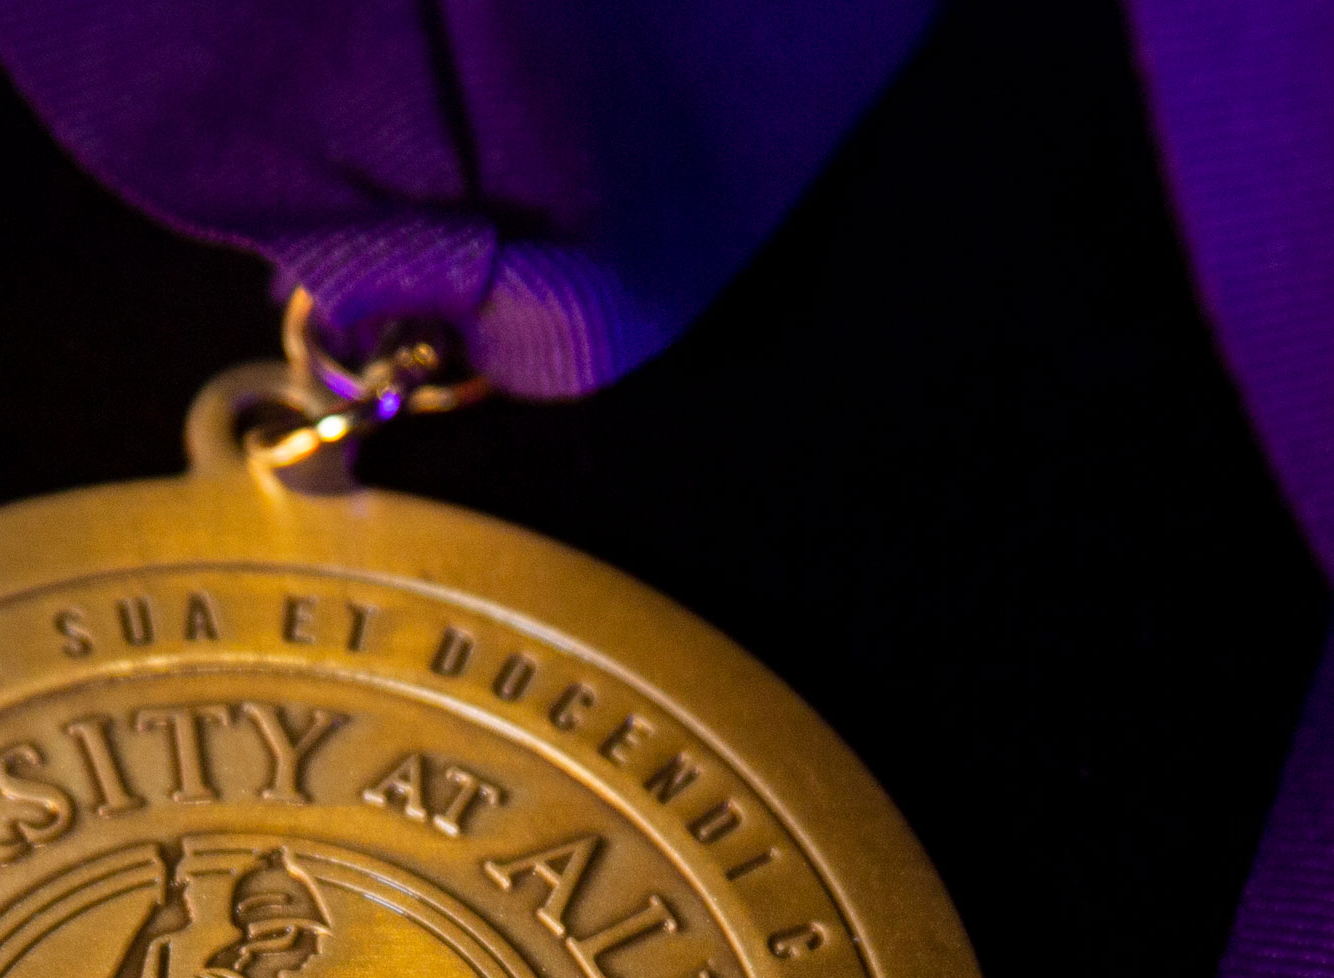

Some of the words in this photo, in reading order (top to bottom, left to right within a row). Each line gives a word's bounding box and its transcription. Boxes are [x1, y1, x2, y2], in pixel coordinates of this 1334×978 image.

[55, 591, 219, 656] SUA
[283, 597, 380, 652] ET
[432, 627, 781, 881] DOCENDI
[363, 754, 505, 836] AT
